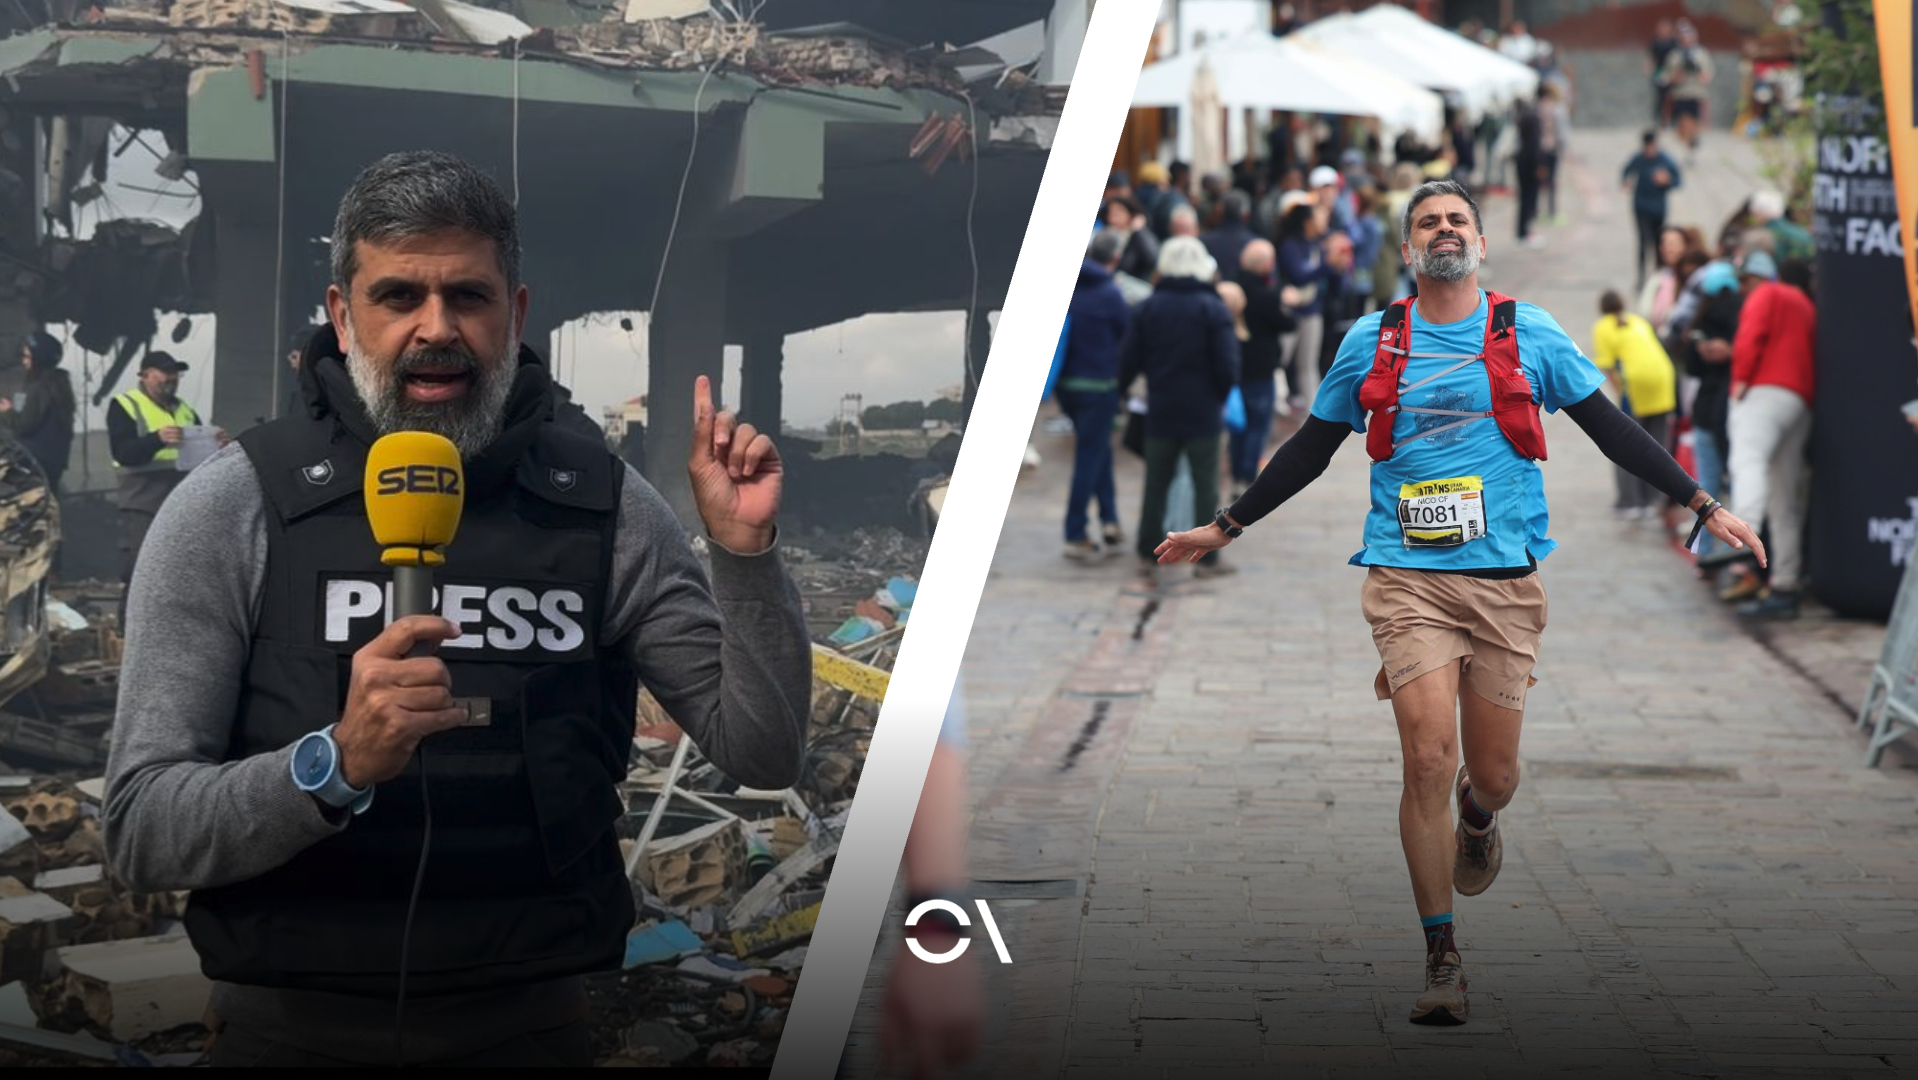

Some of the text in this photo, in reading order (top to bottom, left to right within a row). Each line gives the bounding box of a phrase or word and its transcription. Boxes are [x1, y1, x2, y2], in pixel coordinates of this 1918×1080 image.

[376, 464, 460, 495] SER
[1417, 495, 1449, 505] NICO CF
[1409, 504, 1458, 524] 7081
[324, 580, 584, 652] PESS
